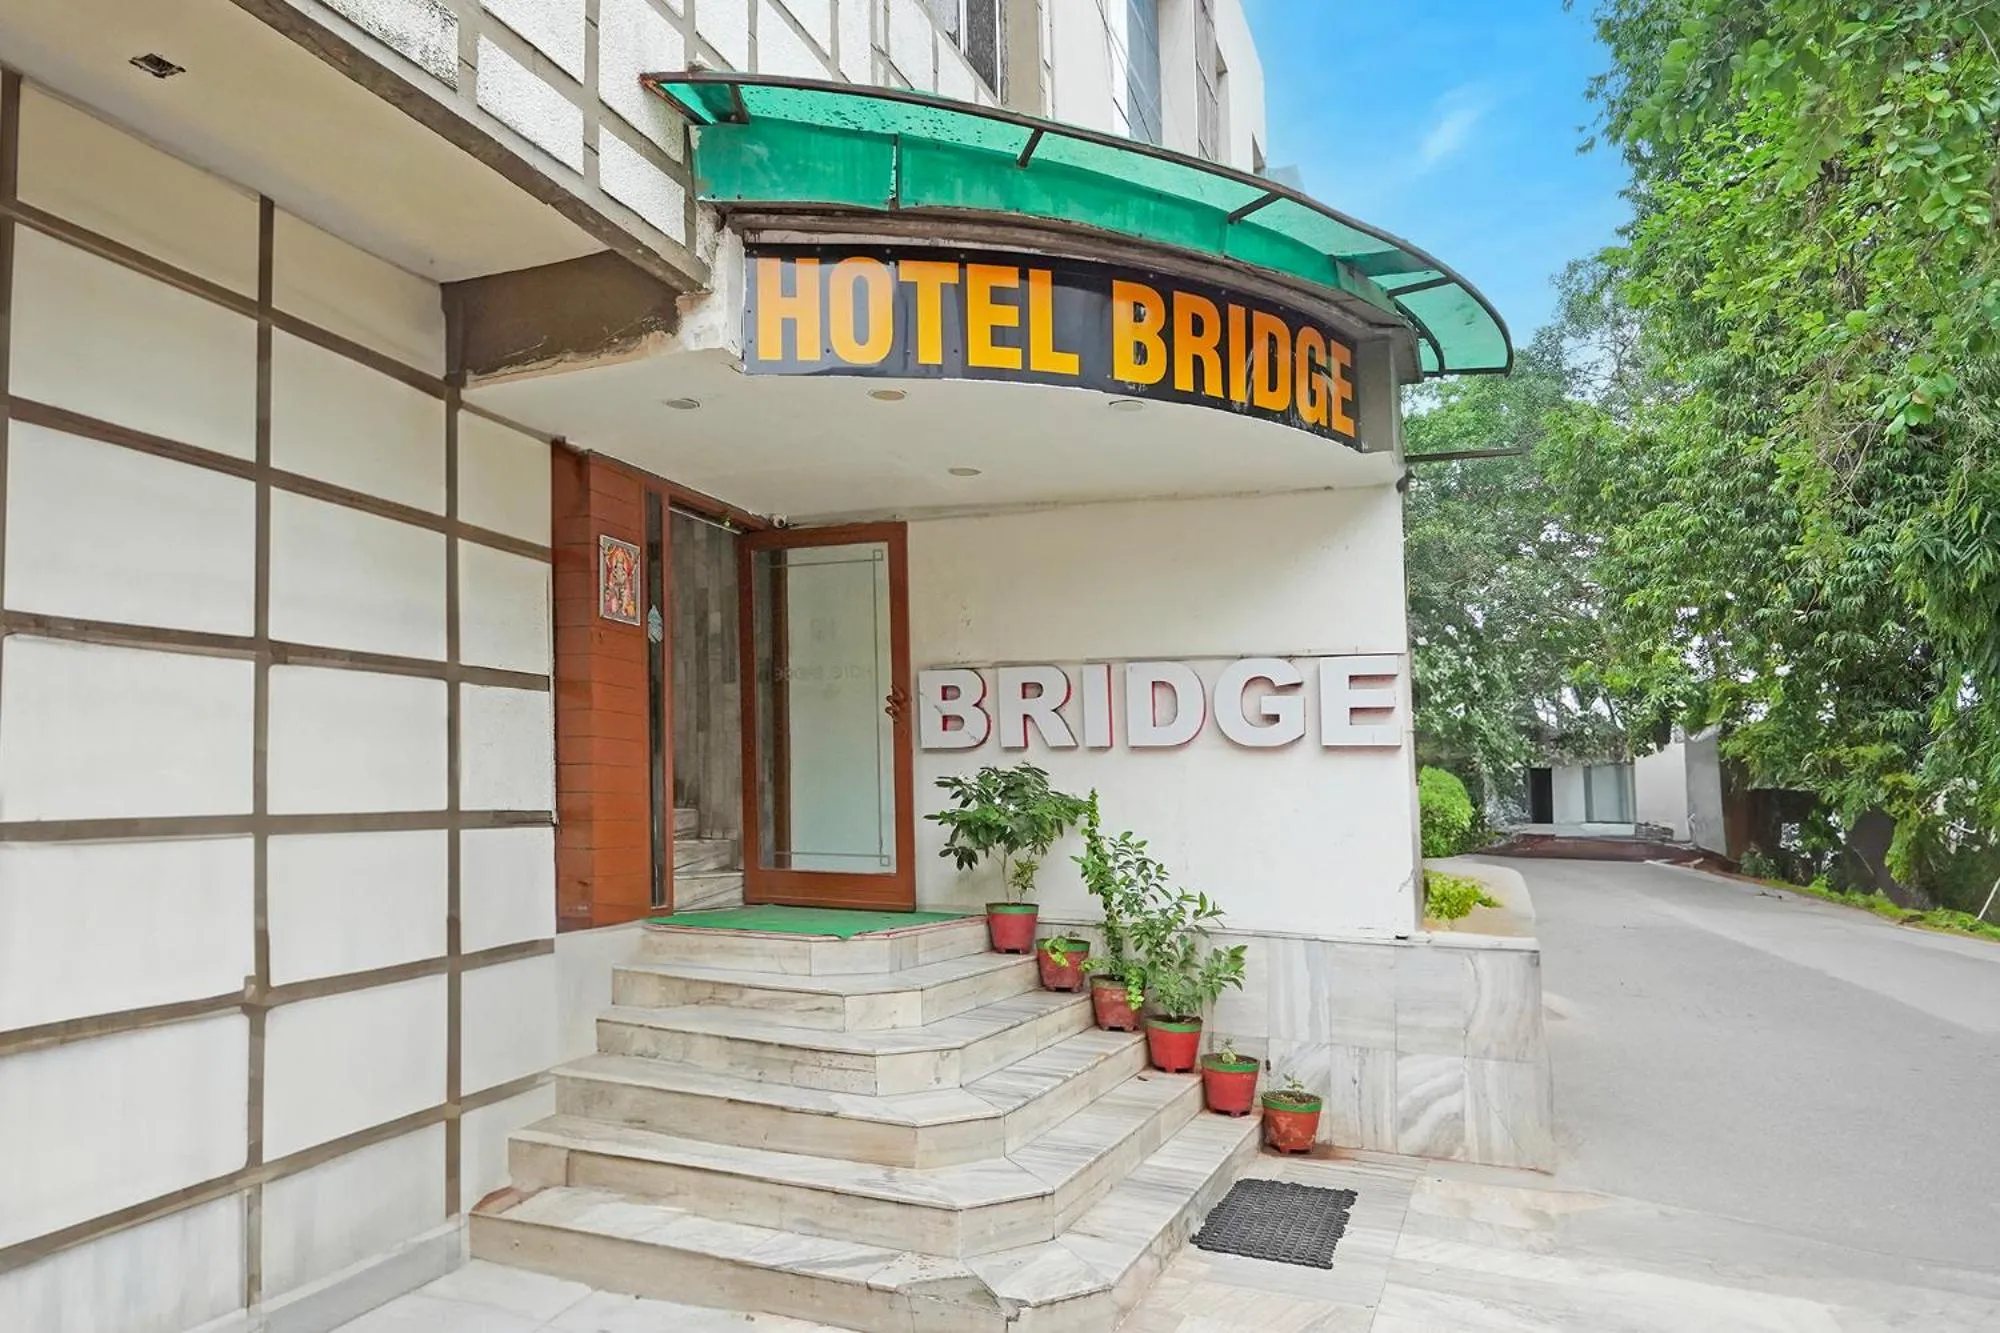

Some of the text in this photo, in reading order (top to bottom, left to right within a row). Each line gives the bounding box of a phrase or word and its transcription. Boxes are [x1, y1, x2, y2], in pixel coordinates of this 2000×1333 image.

[756, 257, 1356, 438] HOTEL BRIDGE
[919, 656, 1402, 749] BRIDGE
